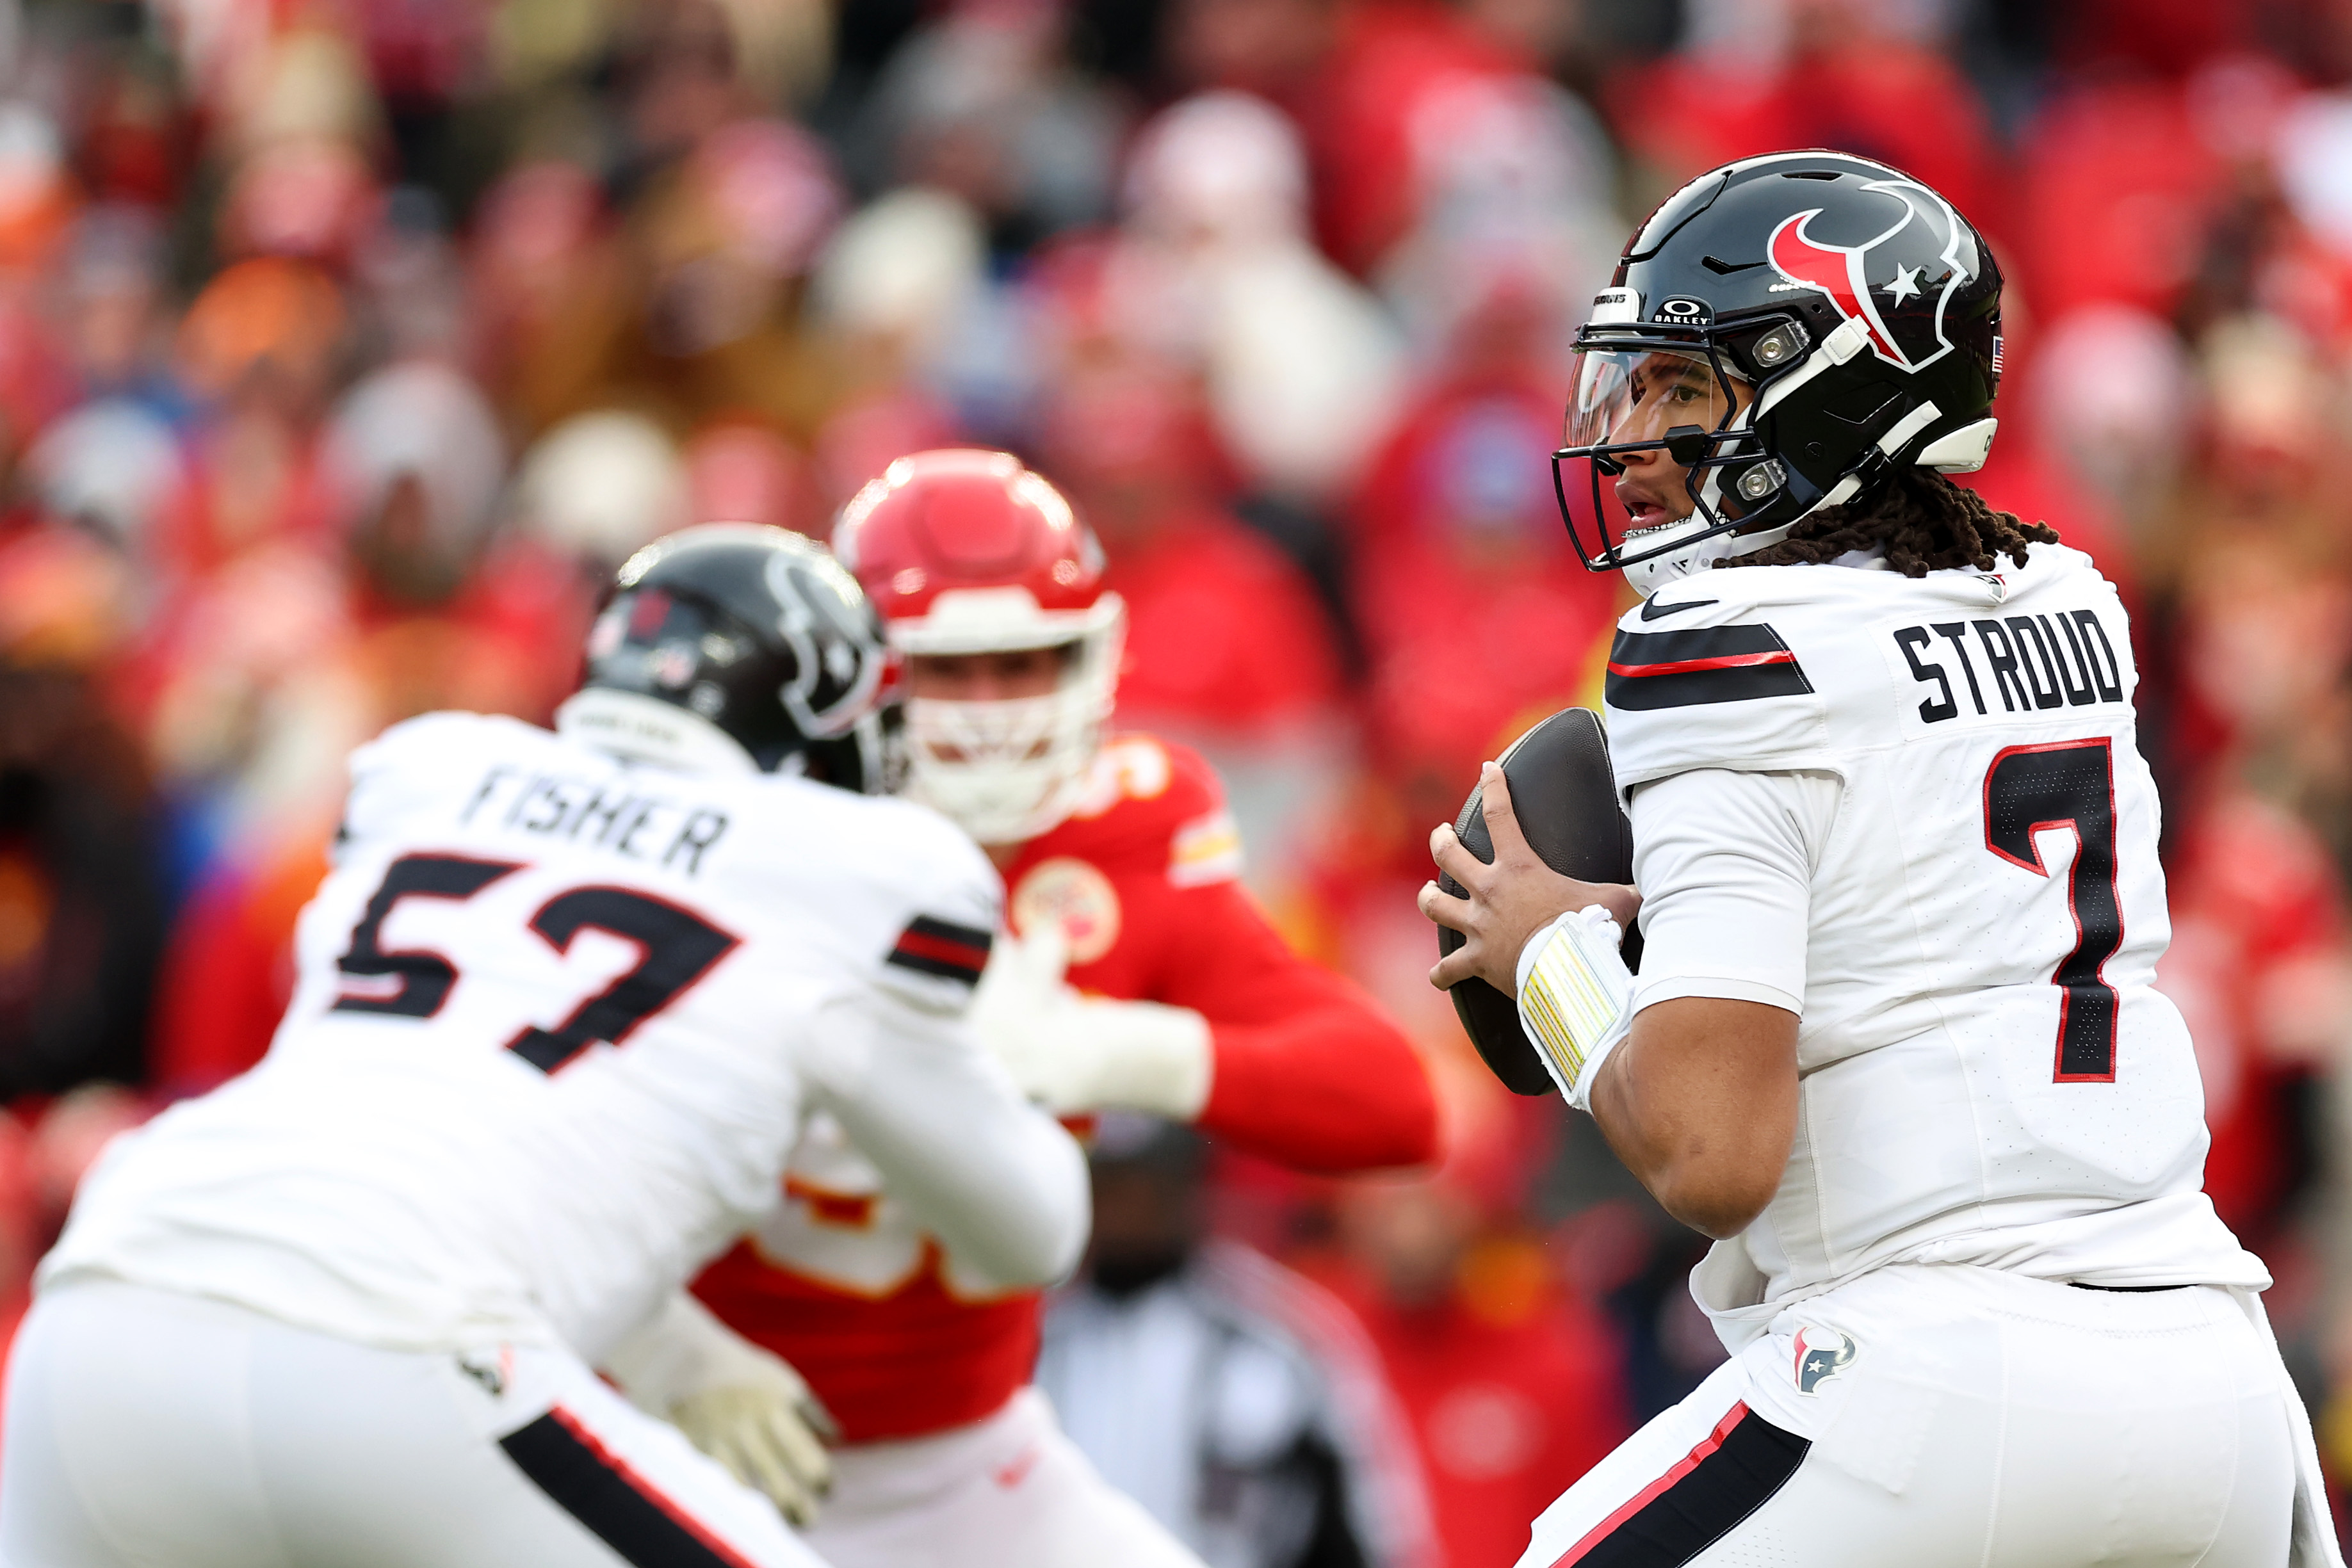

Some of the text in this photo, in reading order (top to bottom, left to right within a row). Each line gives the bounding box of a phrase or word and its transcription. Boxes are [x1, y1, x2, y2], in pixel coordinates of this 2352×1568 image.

[1655, 314, 1709, 325] OAKLEY
[1894, 610, 2123, 723] STROUD
[460, 762, 730, 878] FISHER
[328, 849, 747, 1077] 57
[1983, 736, 2124, 1083] 7
